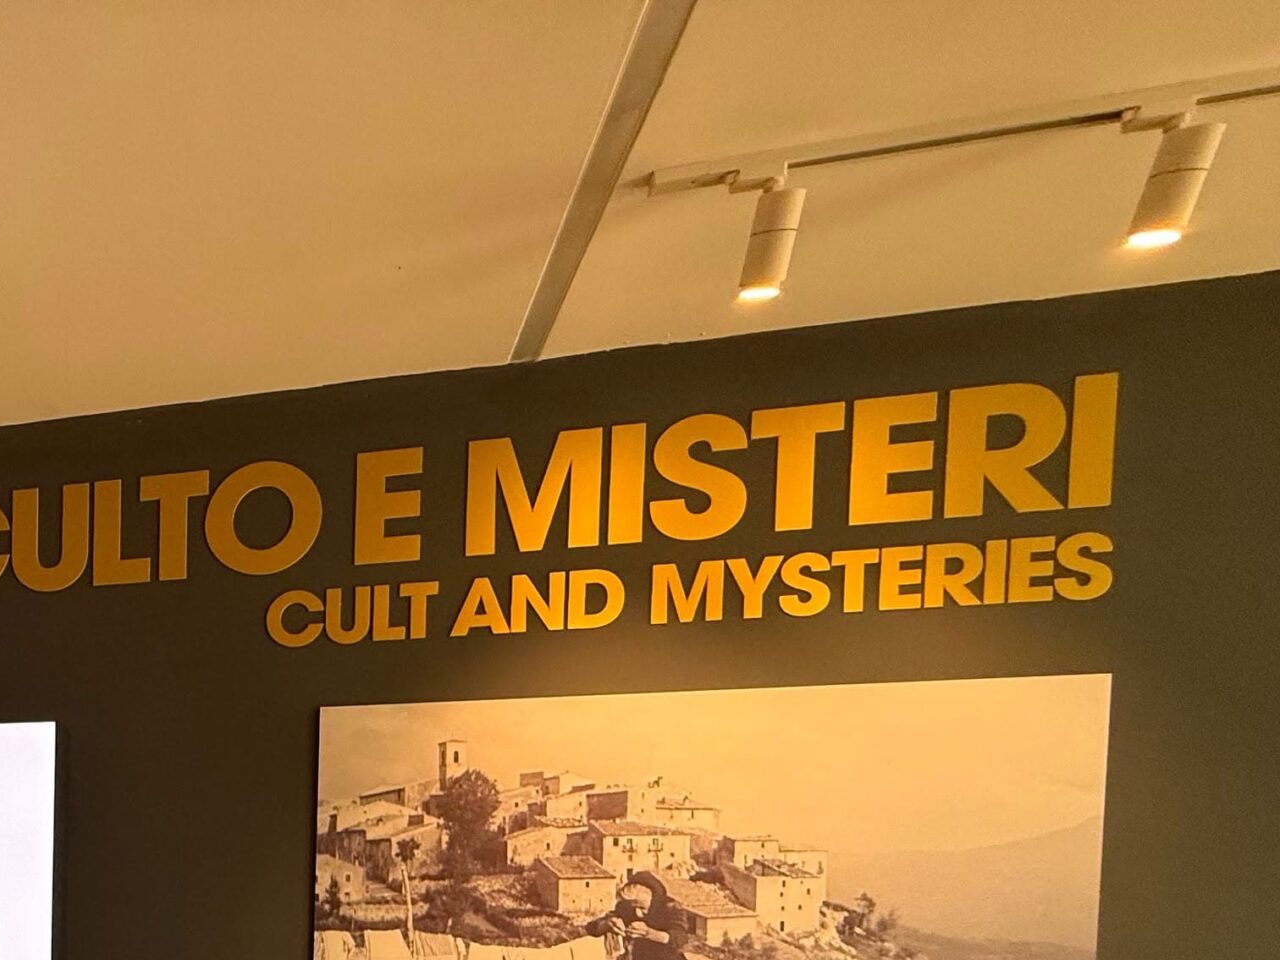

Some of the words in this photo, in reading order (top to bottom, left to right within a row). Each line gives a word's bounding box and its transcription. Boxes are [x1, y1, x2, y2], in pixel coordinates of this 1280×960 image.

[354, 445, 424, 566] E
[465, 371, 1120, 557] MISTERI
[265, 579, 439, 649] CULT
[449, 568, 626, 638] AND
[649, 531, 1114, 627] MYSTERIES
